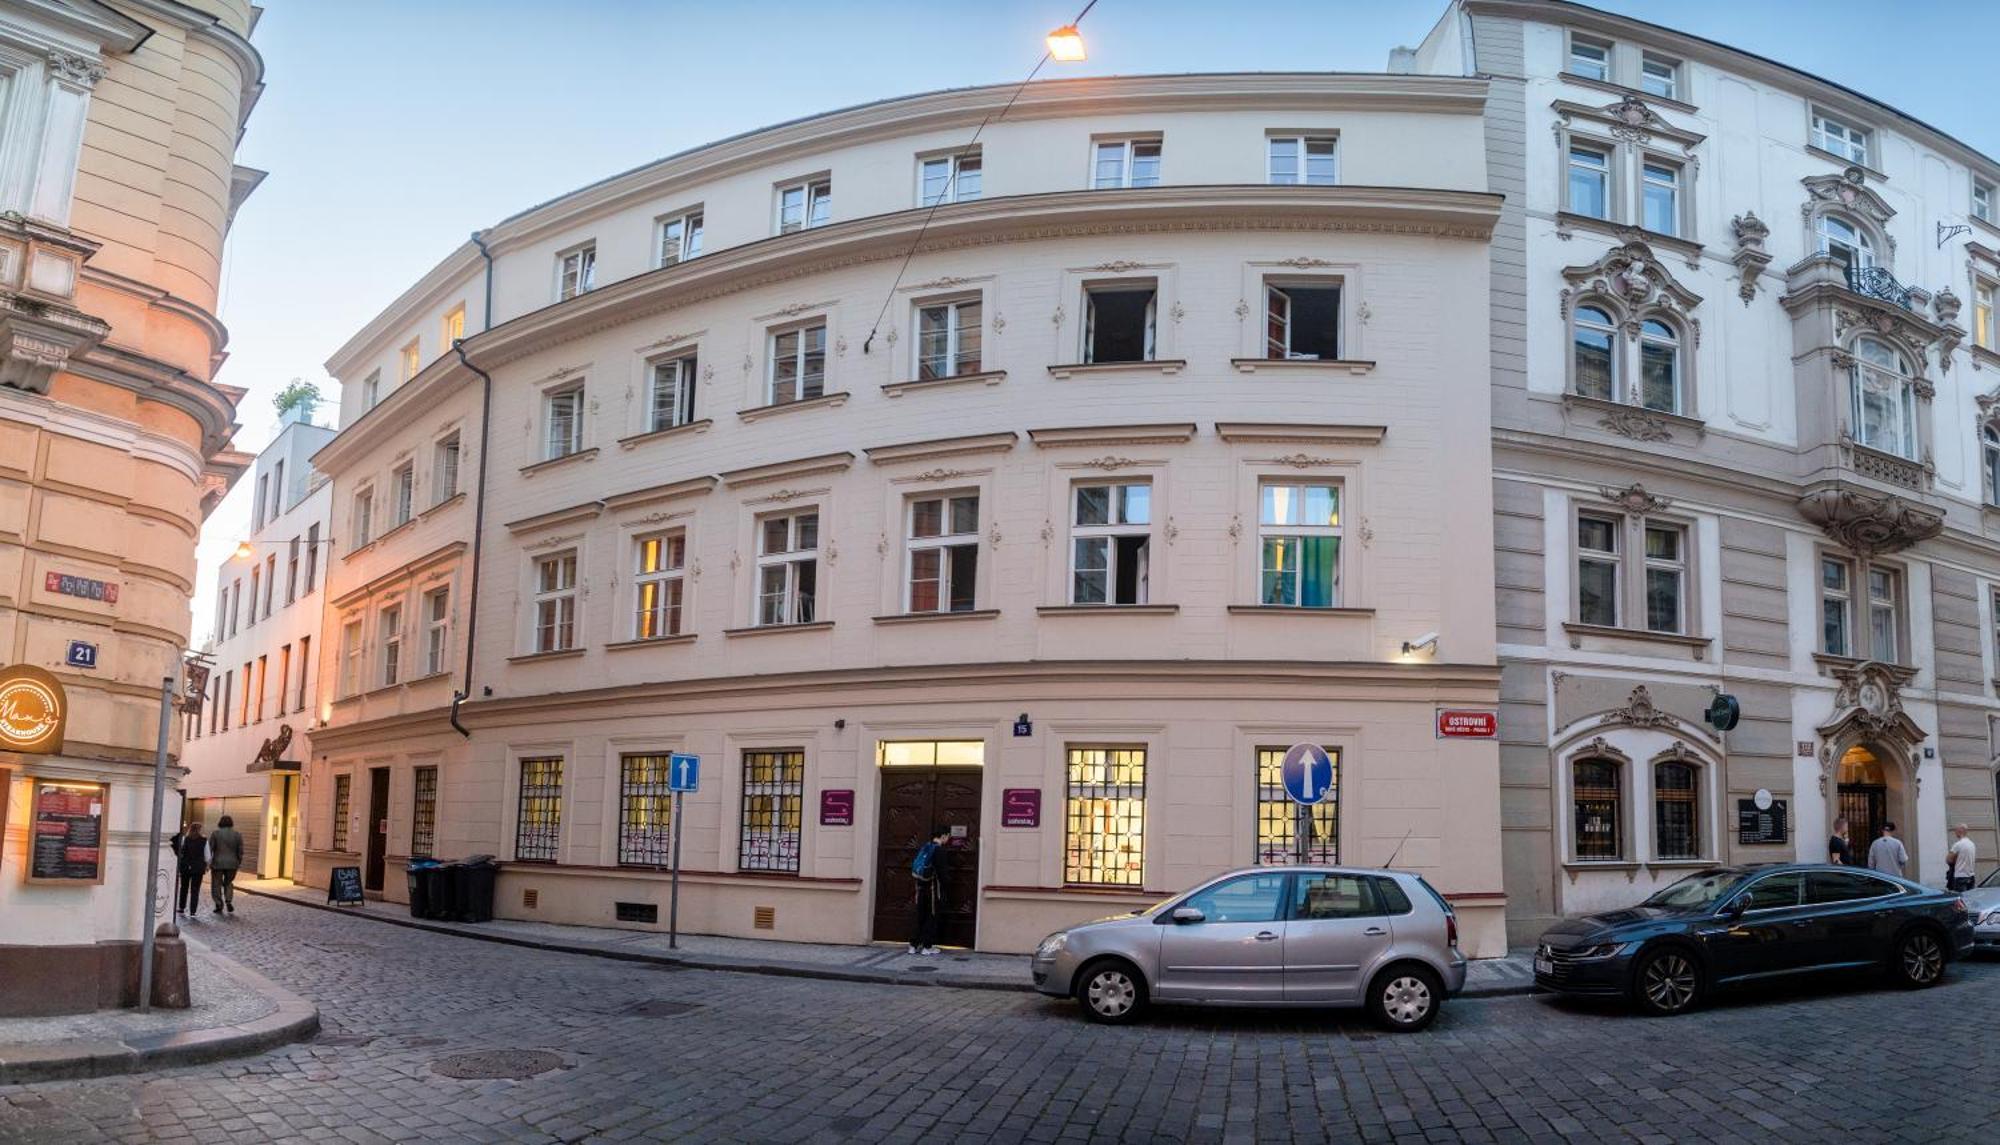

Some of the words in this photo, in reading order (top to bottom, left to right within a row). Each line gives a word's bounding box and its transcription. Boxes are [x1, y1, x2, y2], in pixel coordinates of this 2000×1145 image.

[75, 647, 91, 661] 21
[1018, 724, 1028, 733] 15
[338, 869, 358, 880] BAR
